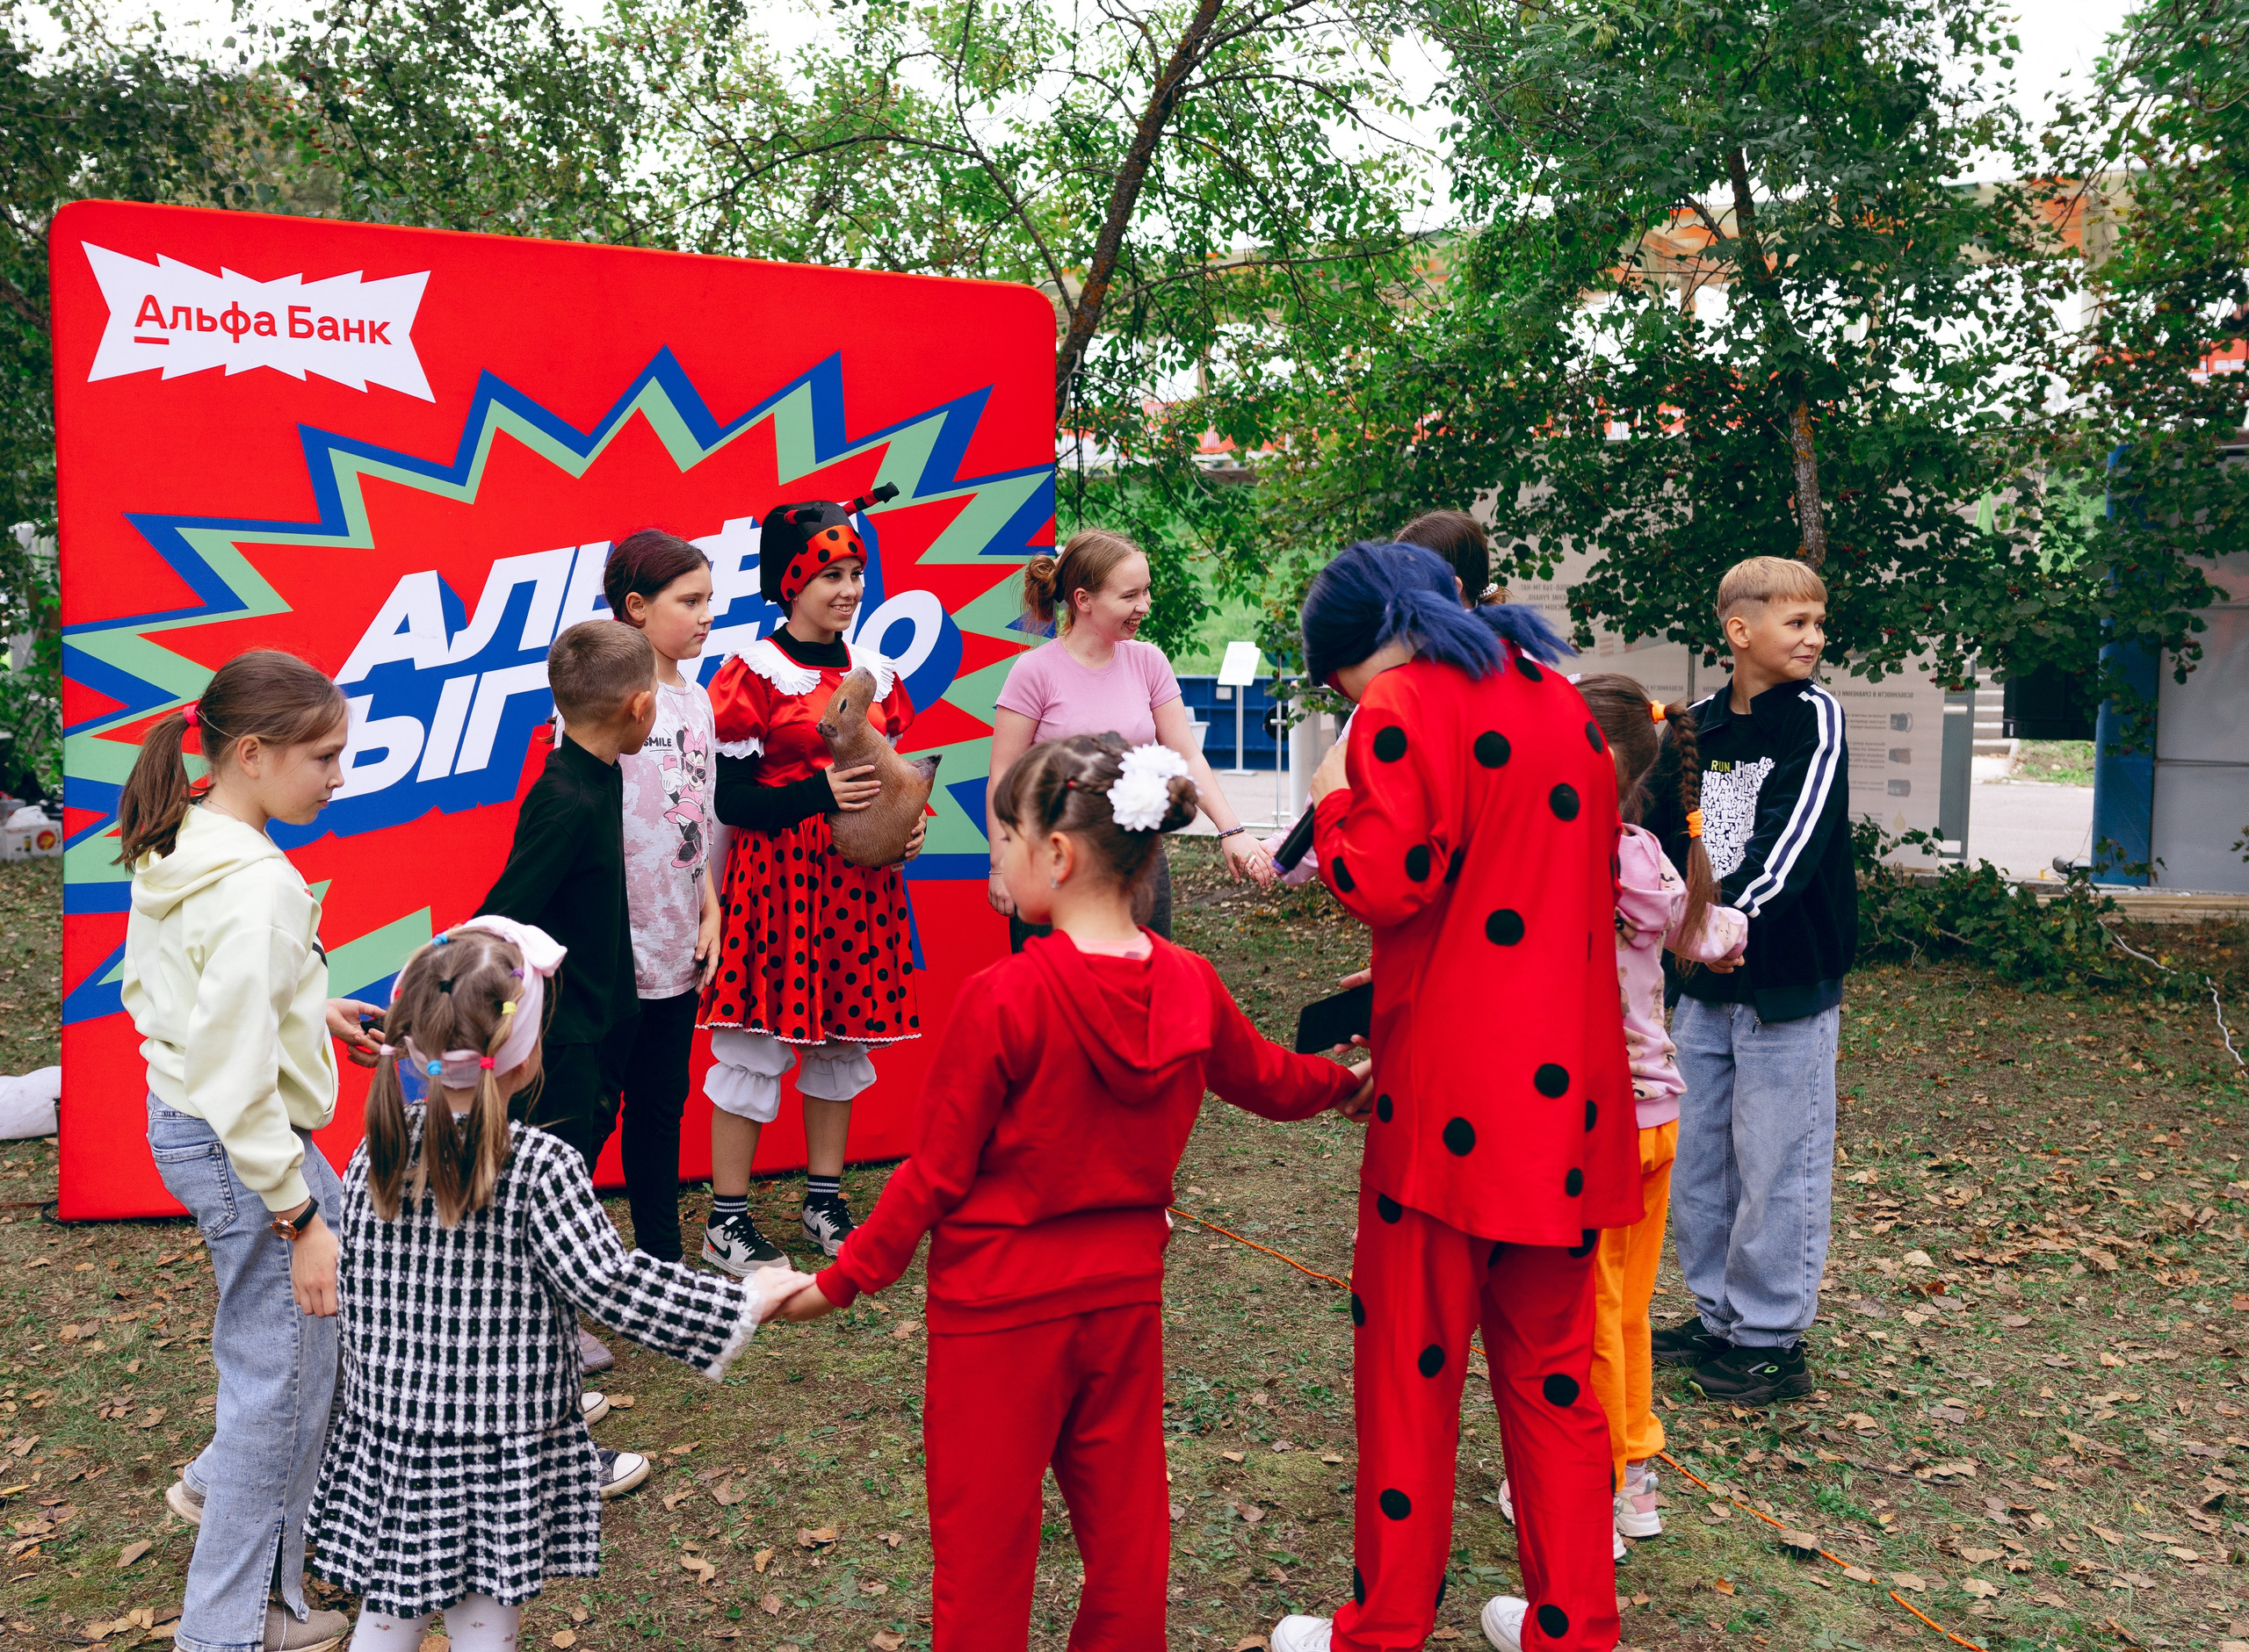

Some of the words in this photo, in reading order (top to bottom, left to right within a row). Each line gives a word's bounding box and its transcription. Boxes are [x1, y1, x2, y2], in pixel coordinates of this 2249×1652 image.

[134, 293, 278, 344] Альфа
[287, 305, 393, 345] Банк
[644, 736, 672, 747] SMILE
[1710, 760, 1731, 773] RUN
